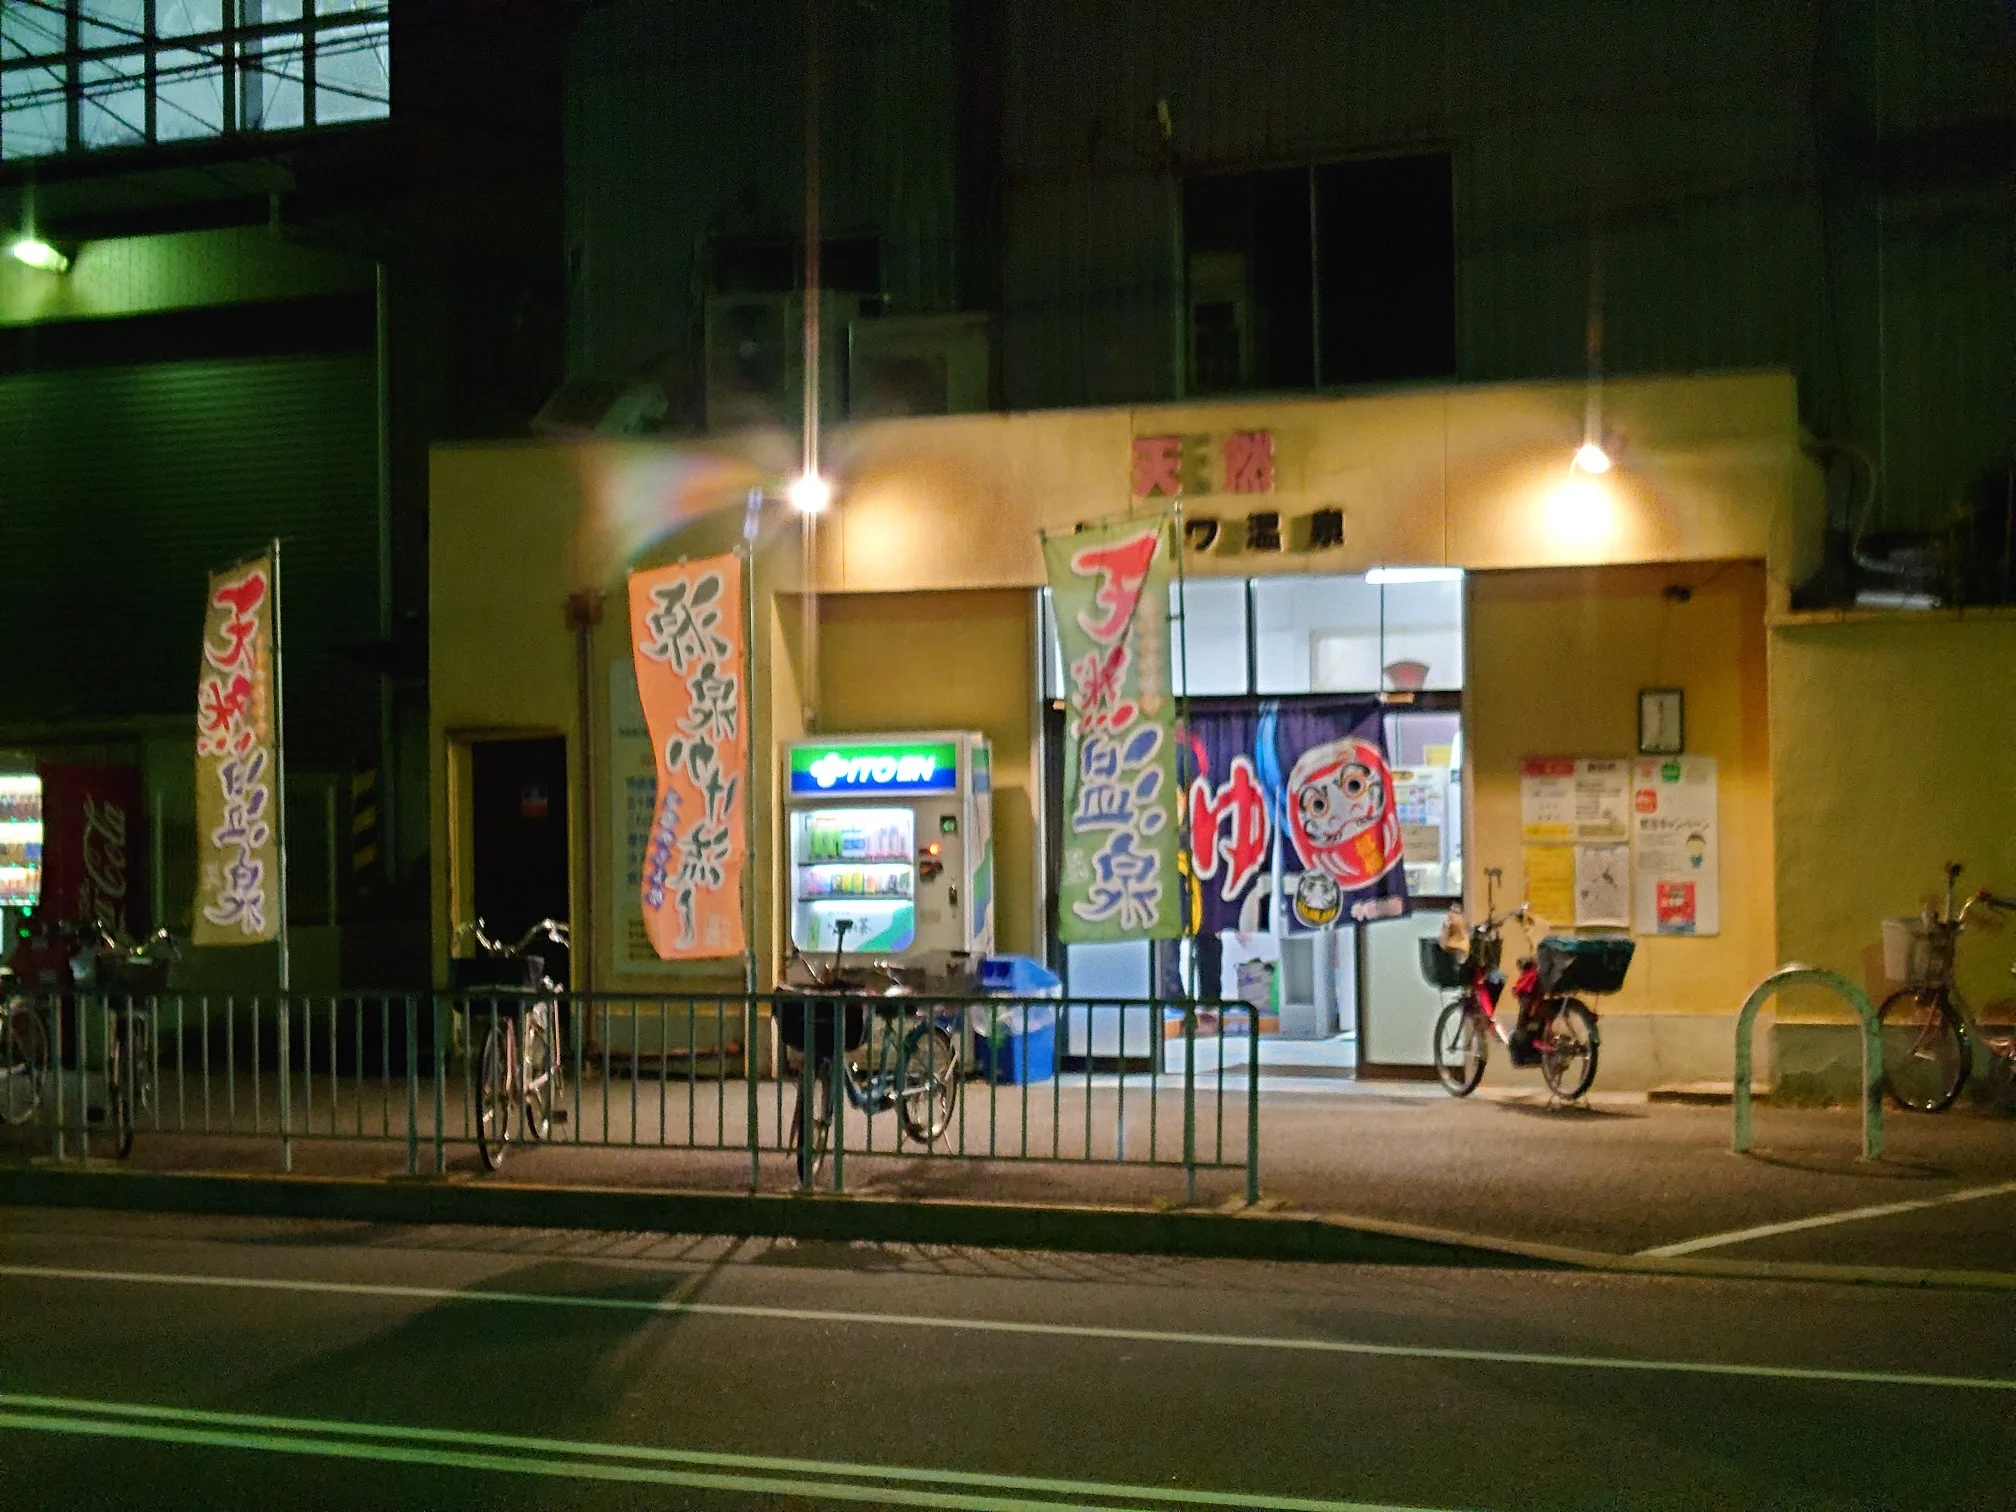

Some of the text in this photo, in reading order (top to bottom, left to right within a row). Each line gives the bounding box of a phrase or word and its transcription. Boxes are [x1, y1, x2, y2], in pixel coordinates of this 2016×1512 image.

[1132, 430, 1275, 498] 天然
[846, 755, 937, 784] ITO EN
[1189, 754, 1272, 903] ゆ
